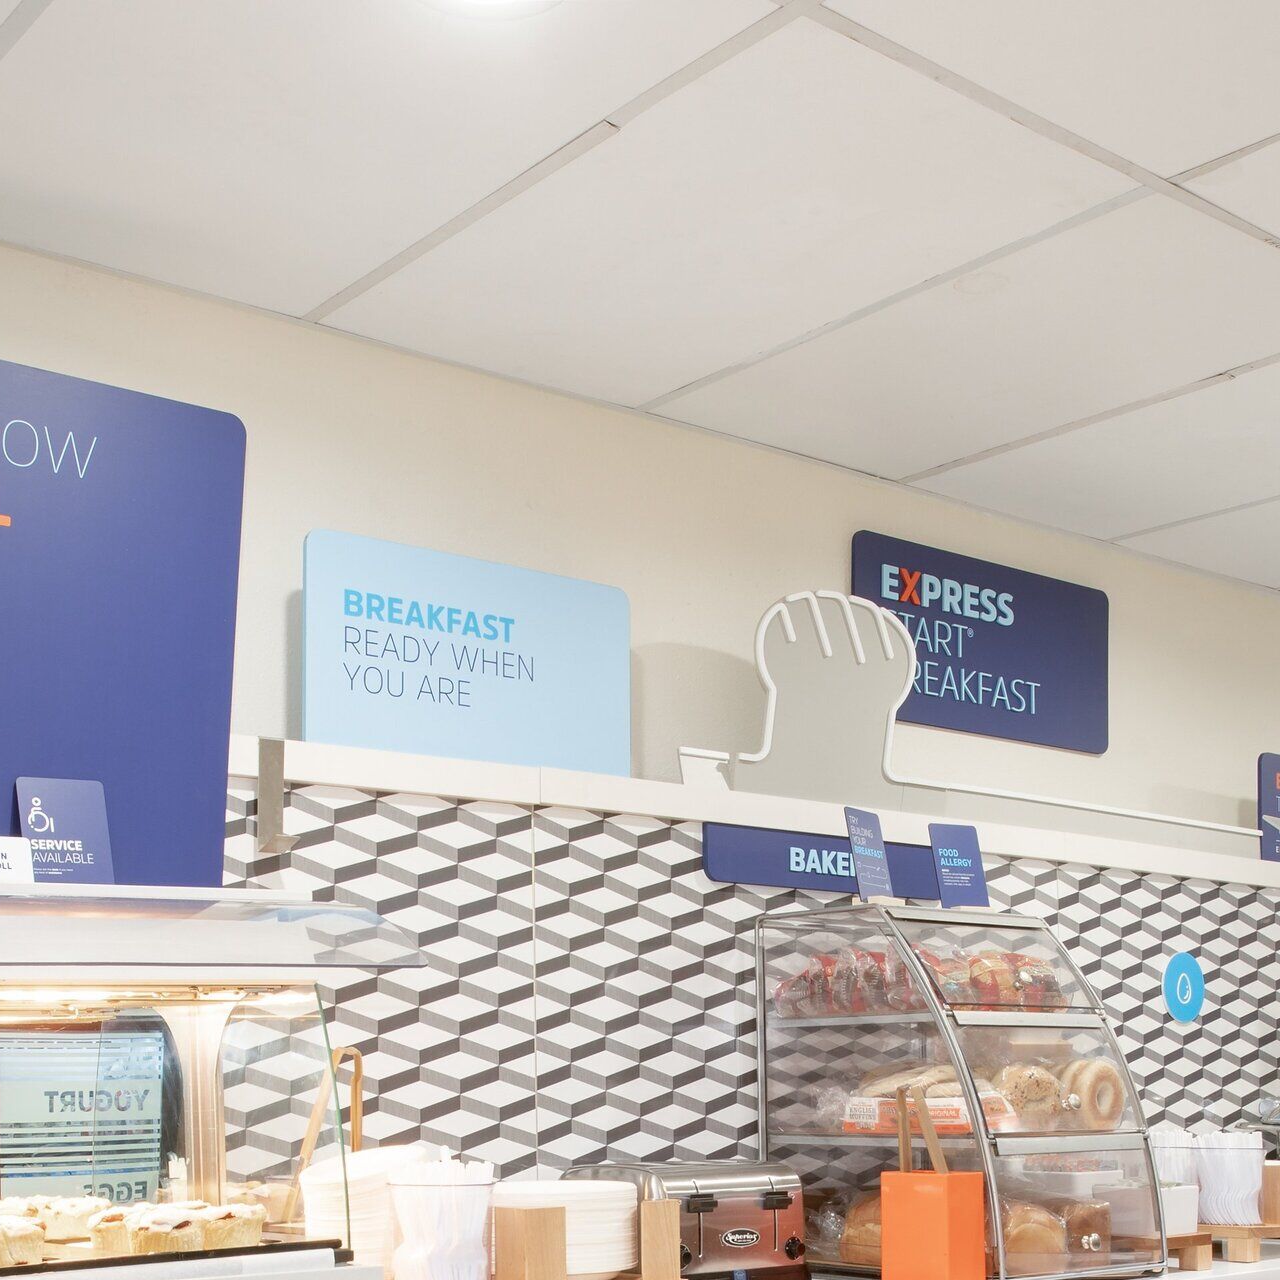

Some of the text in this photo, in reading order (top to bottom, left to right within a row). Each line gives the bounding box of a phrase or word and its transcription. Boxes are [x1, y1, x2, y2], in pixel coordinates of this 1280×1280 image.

[344, 588, 515, 643] BREAKFAST
[881, 563, 1015, 626] EXPRESS
[344, 625, 534, 682] READY WHEN
[342, 661, 471, 707] YOU ARE
[913, 660, 1041, 715] REAKFAST
[31, 839, 83, 851] SERVICE
[32, 852, 95, 865] AVAILABLE
[938, 848, 959, 857] FOOD
[940, 858, 972, 867] ALLERGY
